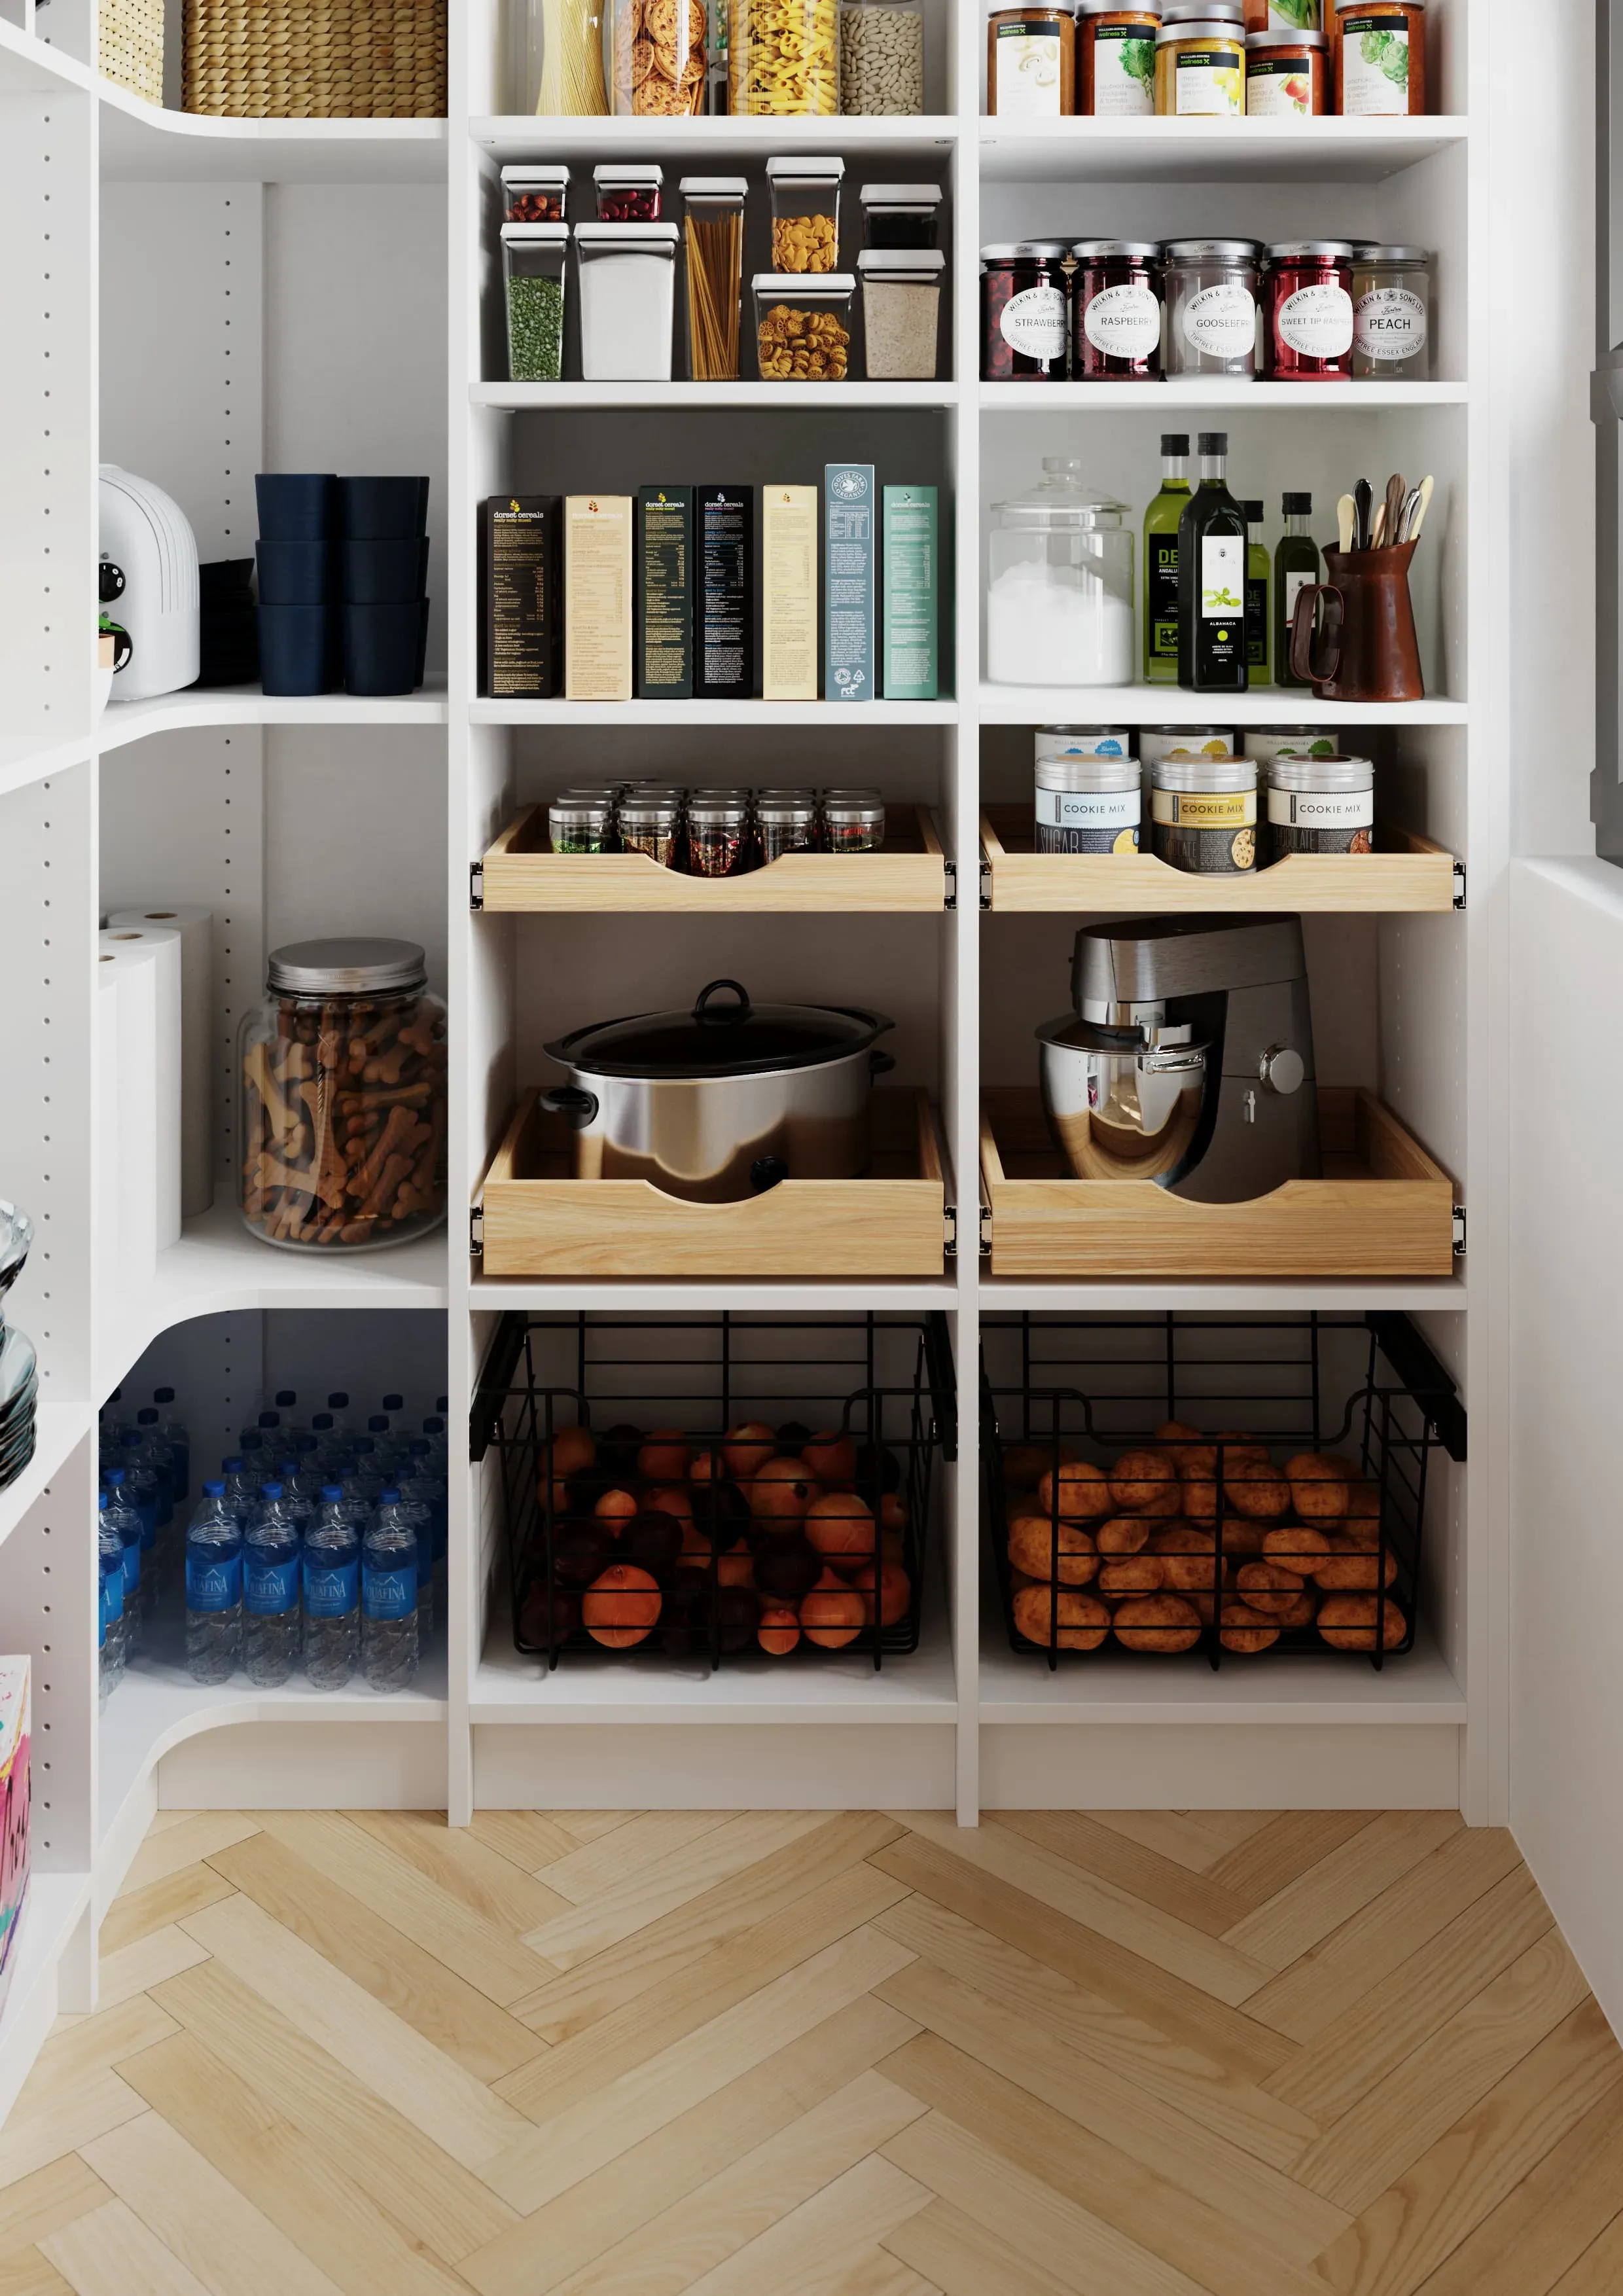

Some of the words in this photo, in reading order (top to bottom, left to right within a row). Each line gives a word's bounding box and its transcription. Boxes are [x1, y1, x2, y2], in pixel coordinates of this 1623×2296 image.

[1008, 293, 1031, 312] WILKIN
[1092, 292, 1113, 310] WILKIN
[1190, 292, 1213, 310] WILKIN
[1286, 292, 1308, 310] WILKIN
[1354, 296, 1374, 314] WILKIN
[1399, 293, 1416, 305] SONS
[1415, 302, 1423, 315] LTD
[1101, 317, 1152, 326] RASPBERRY
[1370, 319, 1411, 330] PEACH
[1092, 333, 1113, 351] TIPTREE
[1191, 332, 1215, 351] TIPTREE
[1287, 332, 1309, 351] TIPTREE
[1355, 336, 1376, 353] TIPTREE
[1402, 334, 1423, 354] ENGLAND
[834, 473, 851, 487] DOVES
[852, 473, 865, 486] FARM
[836, 488, 864, 498] ORGANIC
[1159, 549, 1178, 564] DE
[1064, 804, 1105, 814] COOKIE
[1109, 804, 1126, 813] MIX
[1182, 804, 1223, 814] COOKIE
[1227, 804, 1243, 813] MIX
[1300, 804, 1342, 814] COOKIE
[1346, 804, 1361, 813] MIX
[1041, 827, 1079, 853] SUGAR
